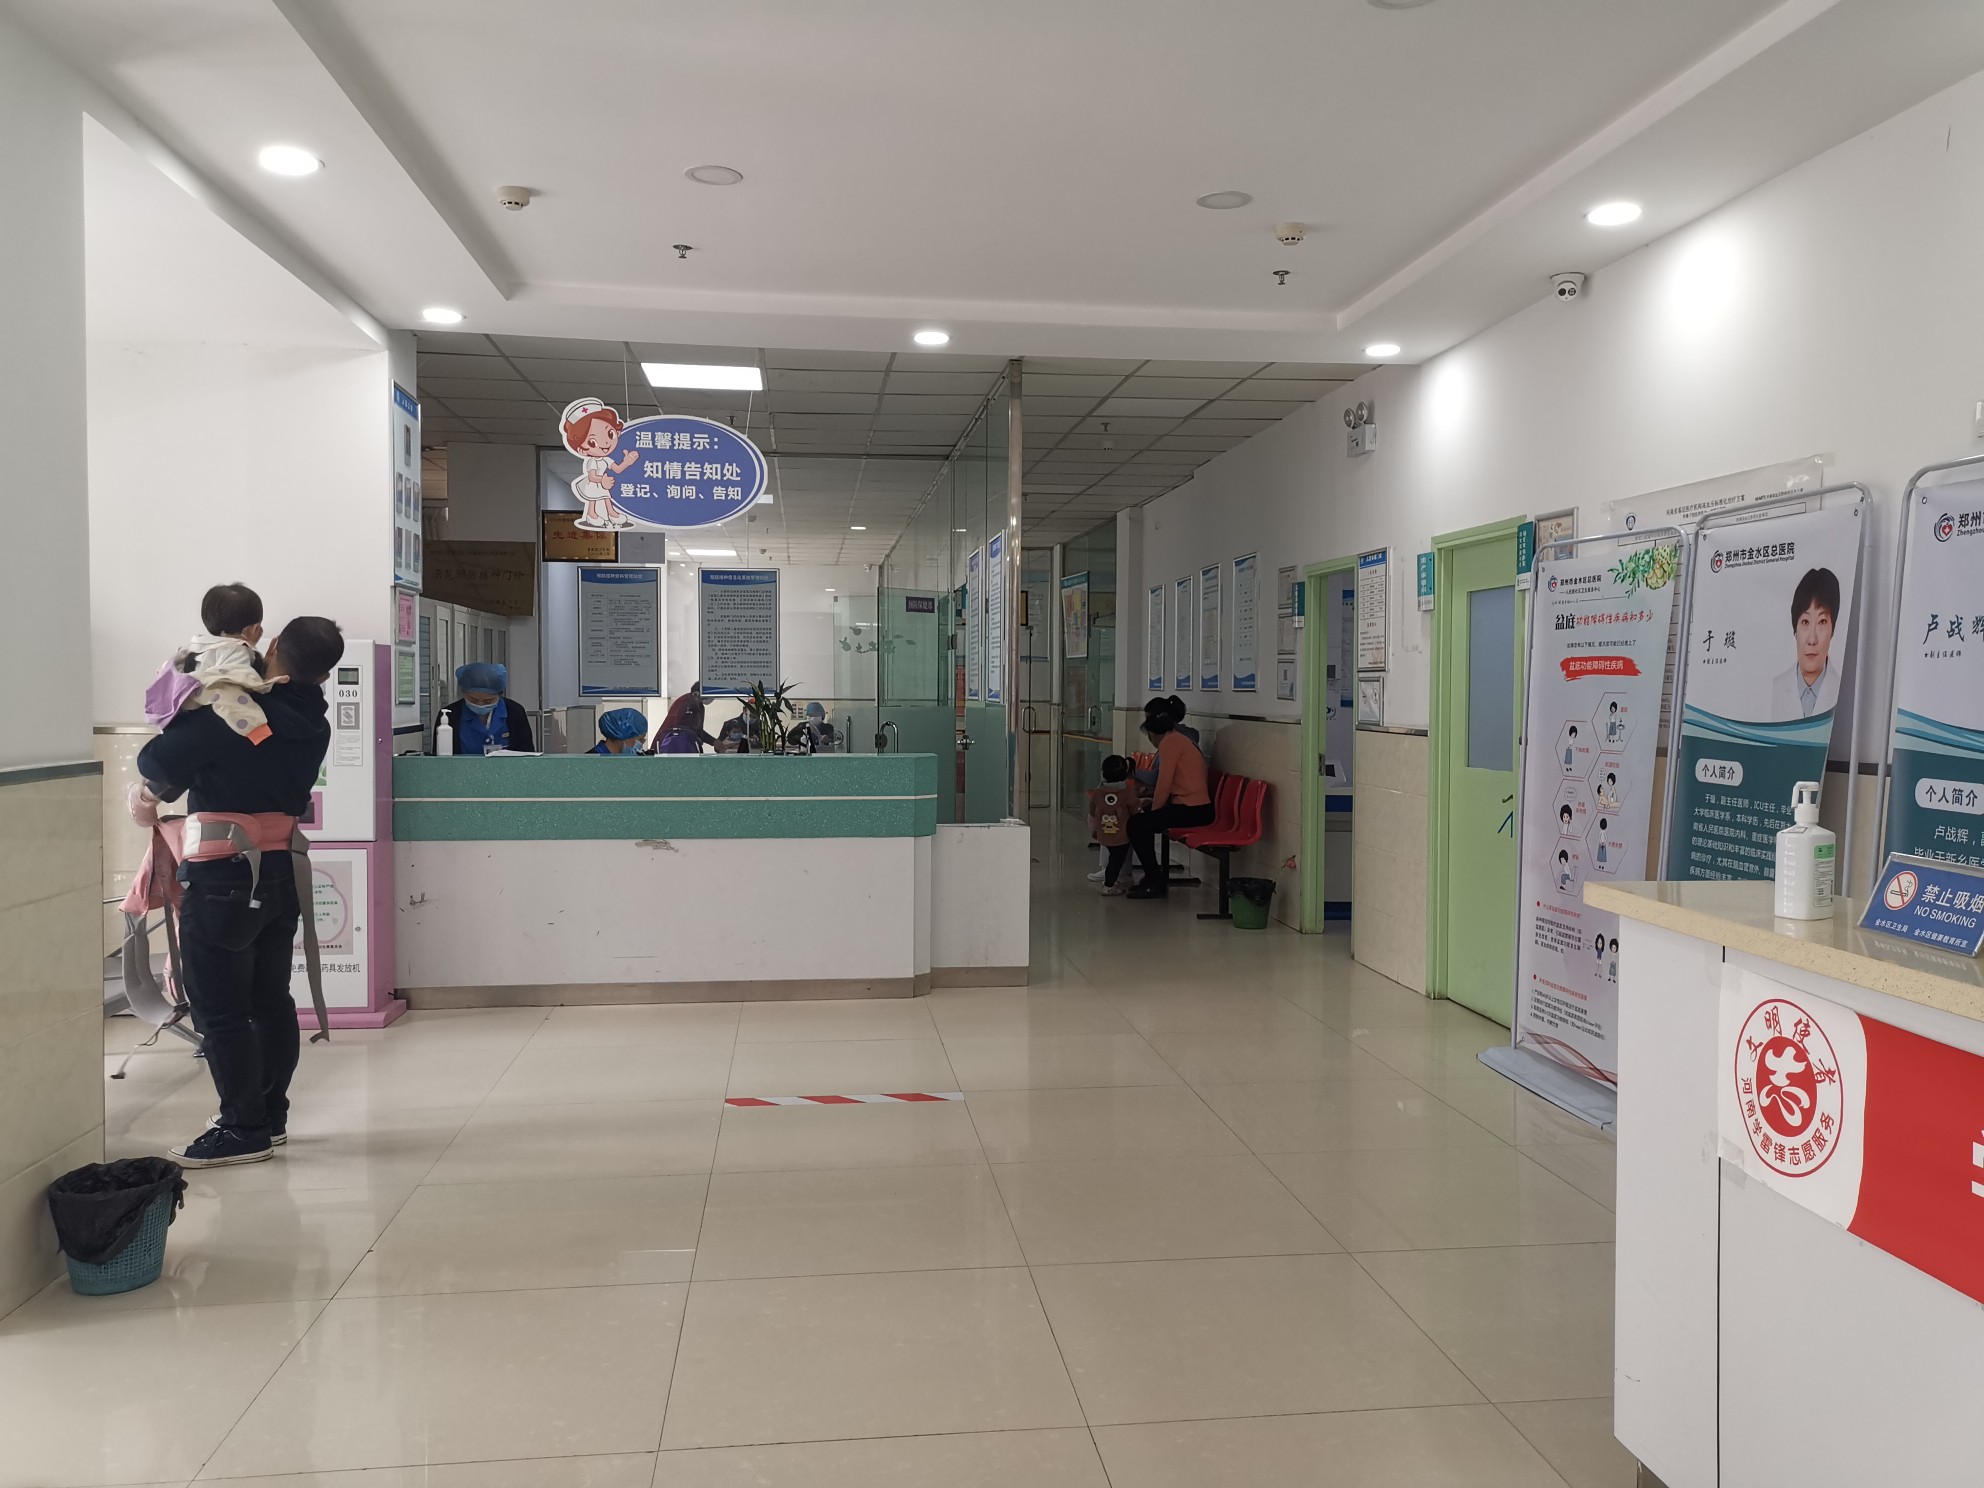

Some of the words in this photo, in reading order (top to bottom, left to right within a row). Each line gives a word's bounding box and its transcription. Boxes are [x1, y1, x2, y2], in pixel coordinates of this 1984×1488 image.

[635, 431, 719, 450] 温馨提示：
[643, 460, 741, 480] 知情告知处
[620, 483, 742, 500] 登记、询问、告知
[1957, 510, 1984, 528] 郑州
[1725, 541, 1795, 562] 郑州市金水区总医院
[1702, 764, 1736, 780] 个人简介
[1925, 785, 1978, 808] 个人简介
[1921, 883, 1984, 914] 禁止吸烟
[1875, 918, 1909, 933] 金水区卫生局
[1914, 905, 1930, 917] NO
[1929, 908, 1977, 928] SMOKING
[1745, 1005, 1837, 1087] 文明使者
[1741, 1077, 1836, 1166] 河南学雷锋志愿服务
